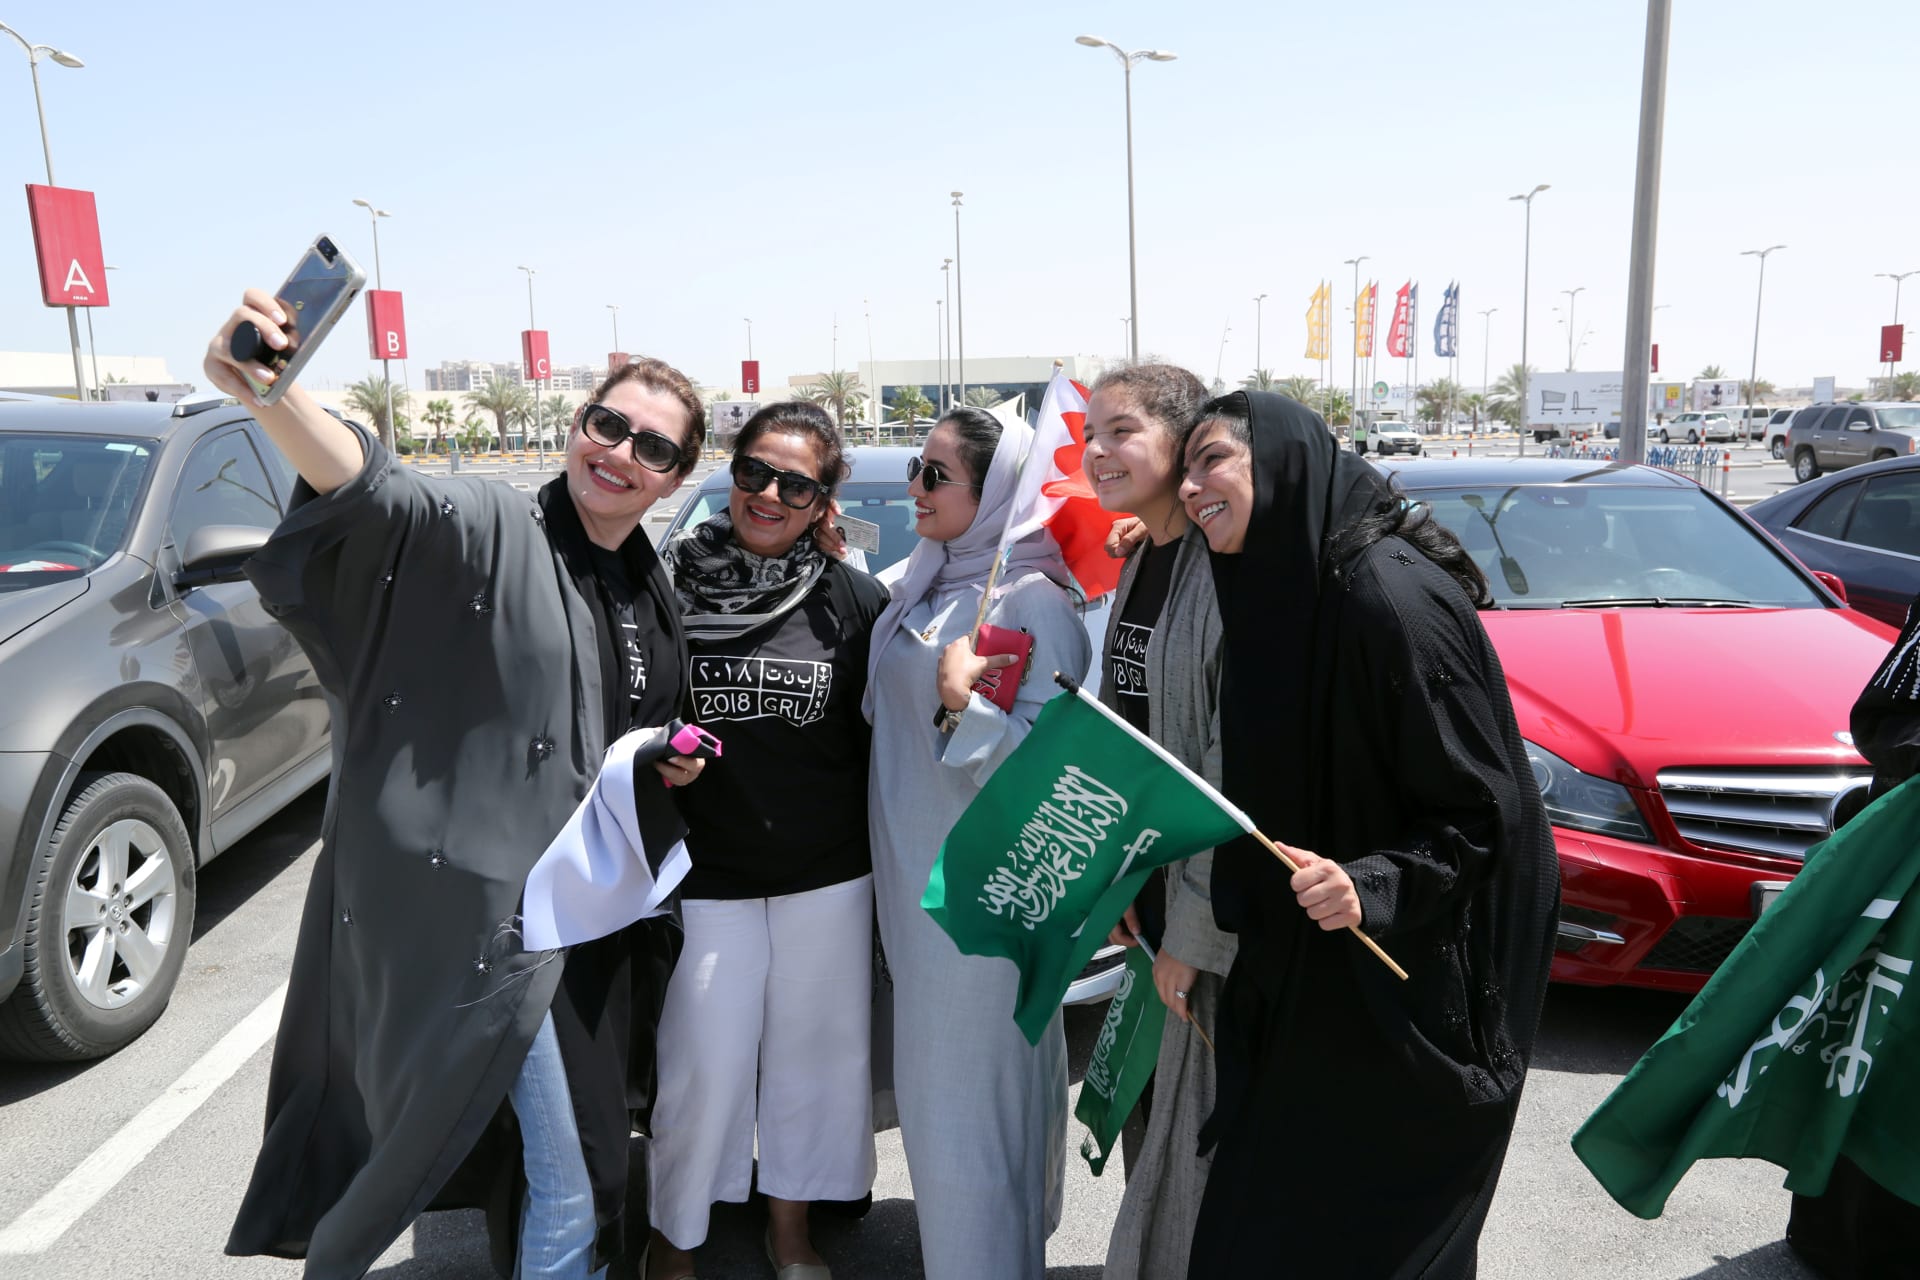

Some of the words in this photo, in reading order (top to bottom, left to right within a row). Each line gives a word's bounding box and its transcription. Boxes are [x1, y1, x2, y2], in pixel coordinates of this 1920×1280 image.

[63, 258, 95, 293] A
[387, 331, 400, 352] B
[537, 358, 547, 374] C
[747, 379, 754, 390] E
[700, 692, 751, 715] 2018
[763, 697, 803, 720] GRL
